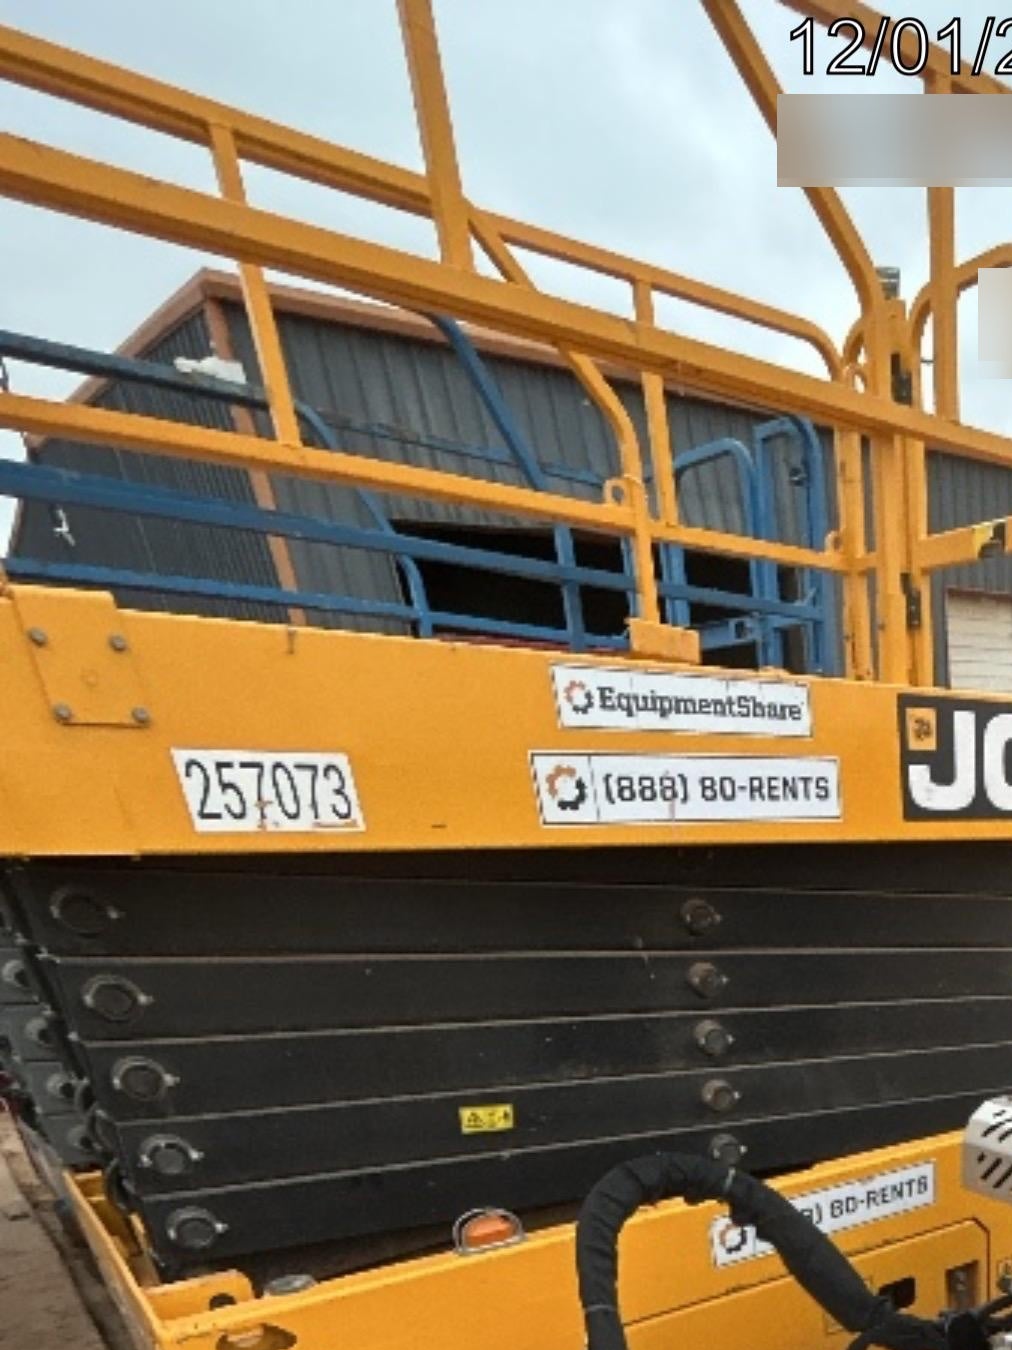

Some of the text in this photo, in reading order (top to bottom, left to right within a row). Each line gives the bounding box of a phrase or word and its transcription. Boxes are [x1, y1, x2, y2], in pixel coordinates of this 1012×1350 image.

[597, 686, 802, 721] EquipmentShare
[185, 759, 351, 820] 257073
[602, 773, 830, 804] (888) 80-RENTS
